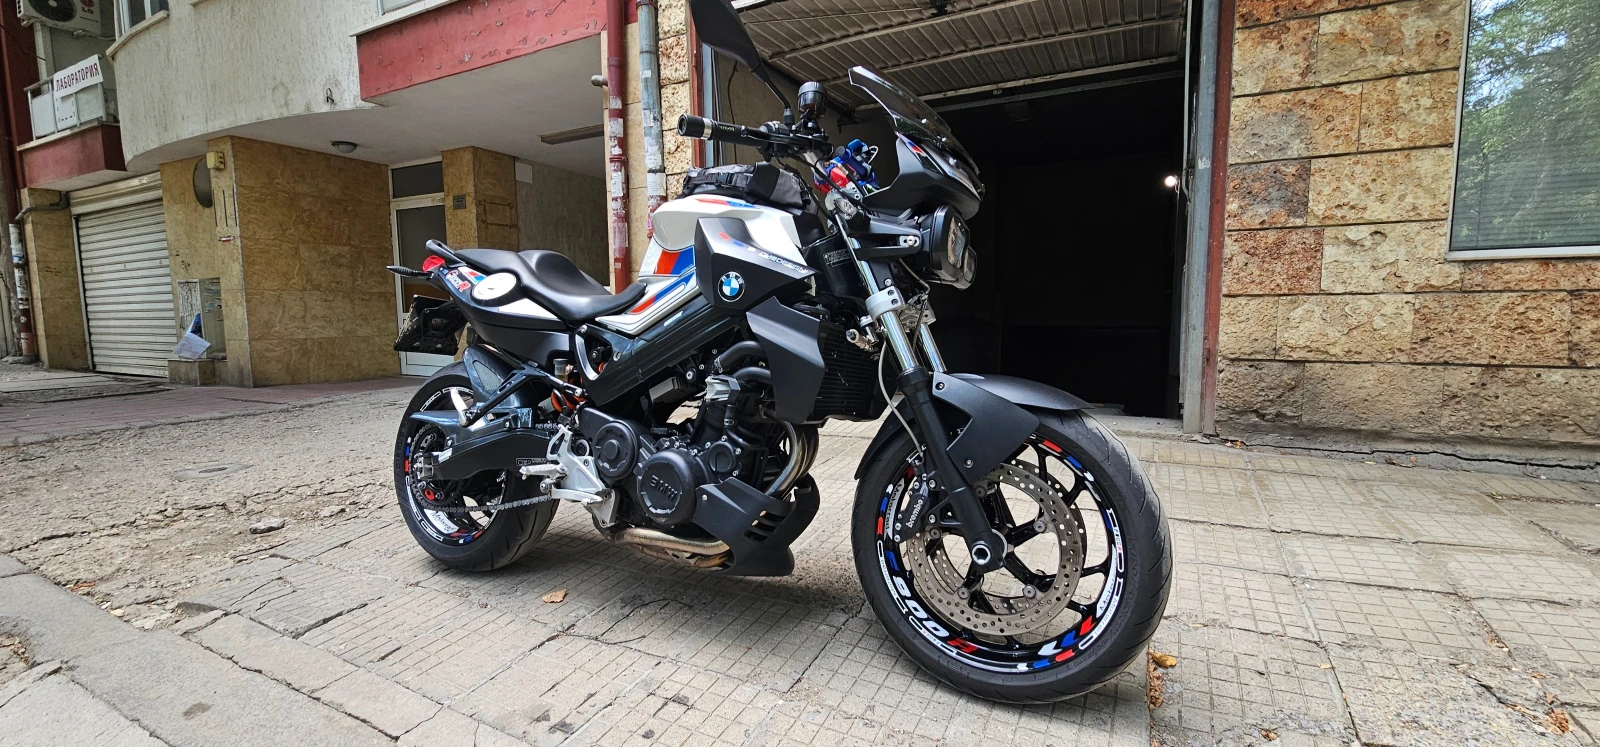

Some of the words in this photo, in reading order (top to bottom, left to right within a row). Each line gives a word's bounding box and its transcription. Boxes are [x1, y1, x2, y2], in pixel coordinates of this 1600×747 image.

[82, 7, 94, 15] LG
[56, 63, 100, 92] ЛАБОРАТОРИЯ
[650, 474, 679, 502] BMW
[885, 482, 902, 530] Motorrad
[905, 498, 923, 529] brembo
